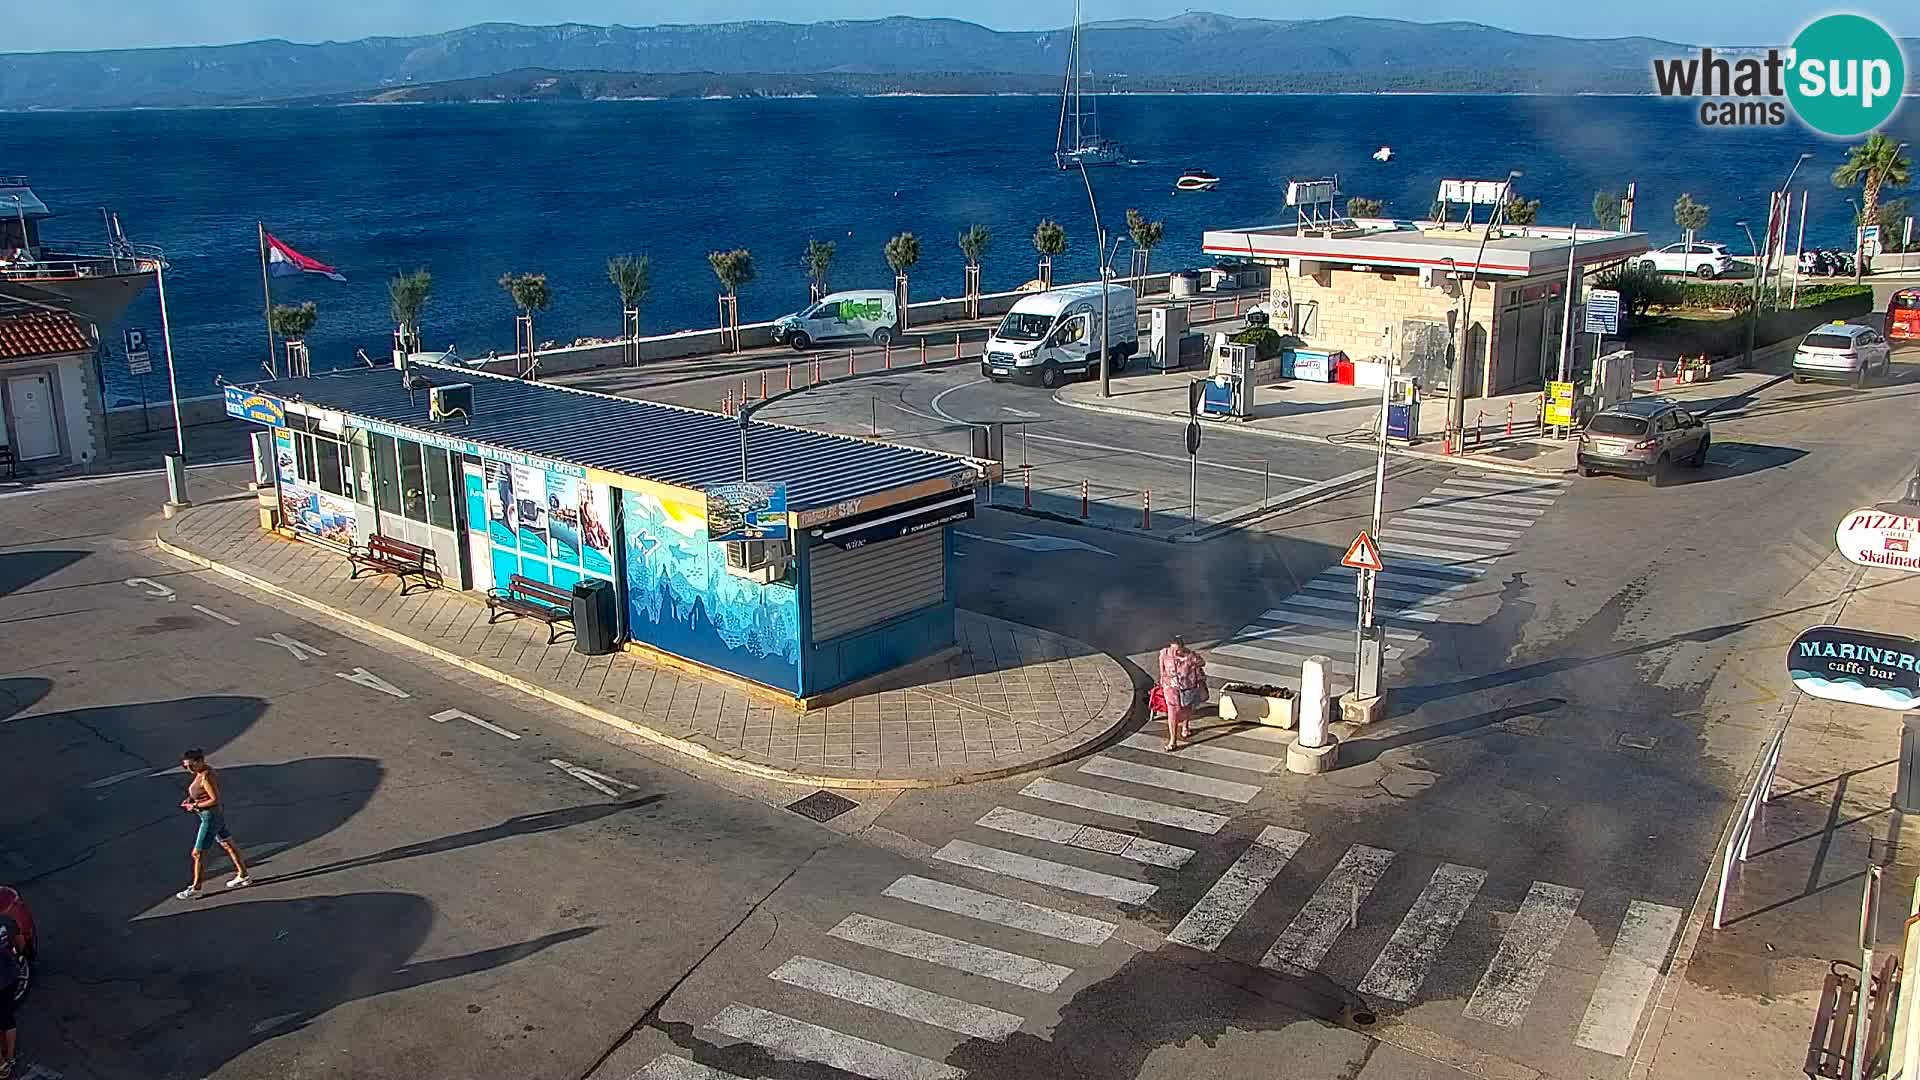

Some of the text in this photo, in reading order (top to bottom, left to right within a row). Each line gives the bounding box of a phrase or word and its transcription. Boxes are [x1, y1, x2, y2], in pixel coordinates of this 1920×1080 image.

[130, 332, 142, 349] P
[494, 448, 525, 465] STATION
[527, 456, 553, 471] TICKET
[554, 461, 583, 477] OFFICE
[1828, 659, 1897, 680] caffe bar
